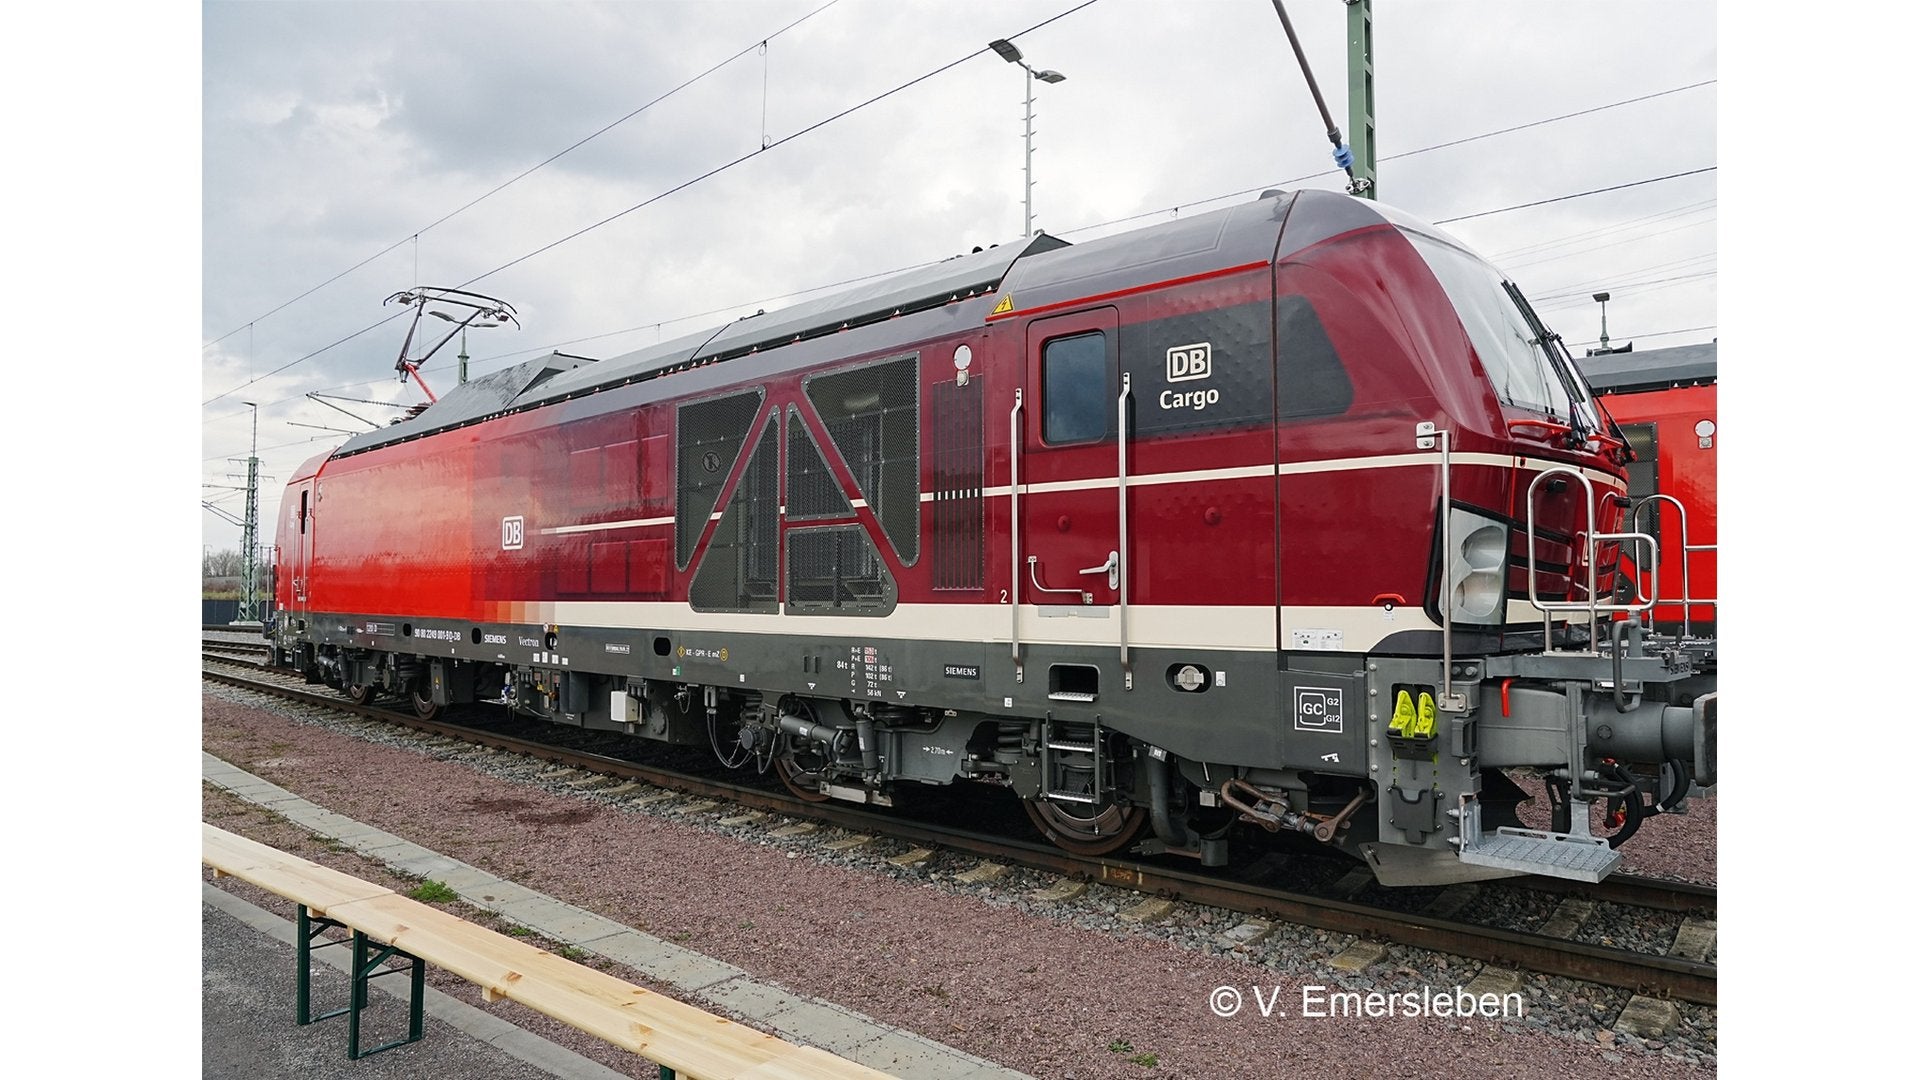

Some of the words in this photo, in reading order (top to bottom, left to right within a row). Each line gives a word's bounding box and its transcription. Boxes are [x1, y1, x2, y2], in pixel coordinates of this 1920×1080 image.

[1171, 347, 1207, 378] DB
[1160, 389, 1219, 410] Cargo
[505, 520, 521, 545] DB
[1000, 589, 1008, 603] 2
[484, 634, 507, 645] SIEMENS
[518, 636, 540, 647] Vectron
[836, 660, 844, 669] 84
[945, 667, 977, 676] SIEMENS
[1327, 697, 1339, 706] G2
[1302, 702, 1323, 715] GC
[1325, 714, 1340, 723] GI2
